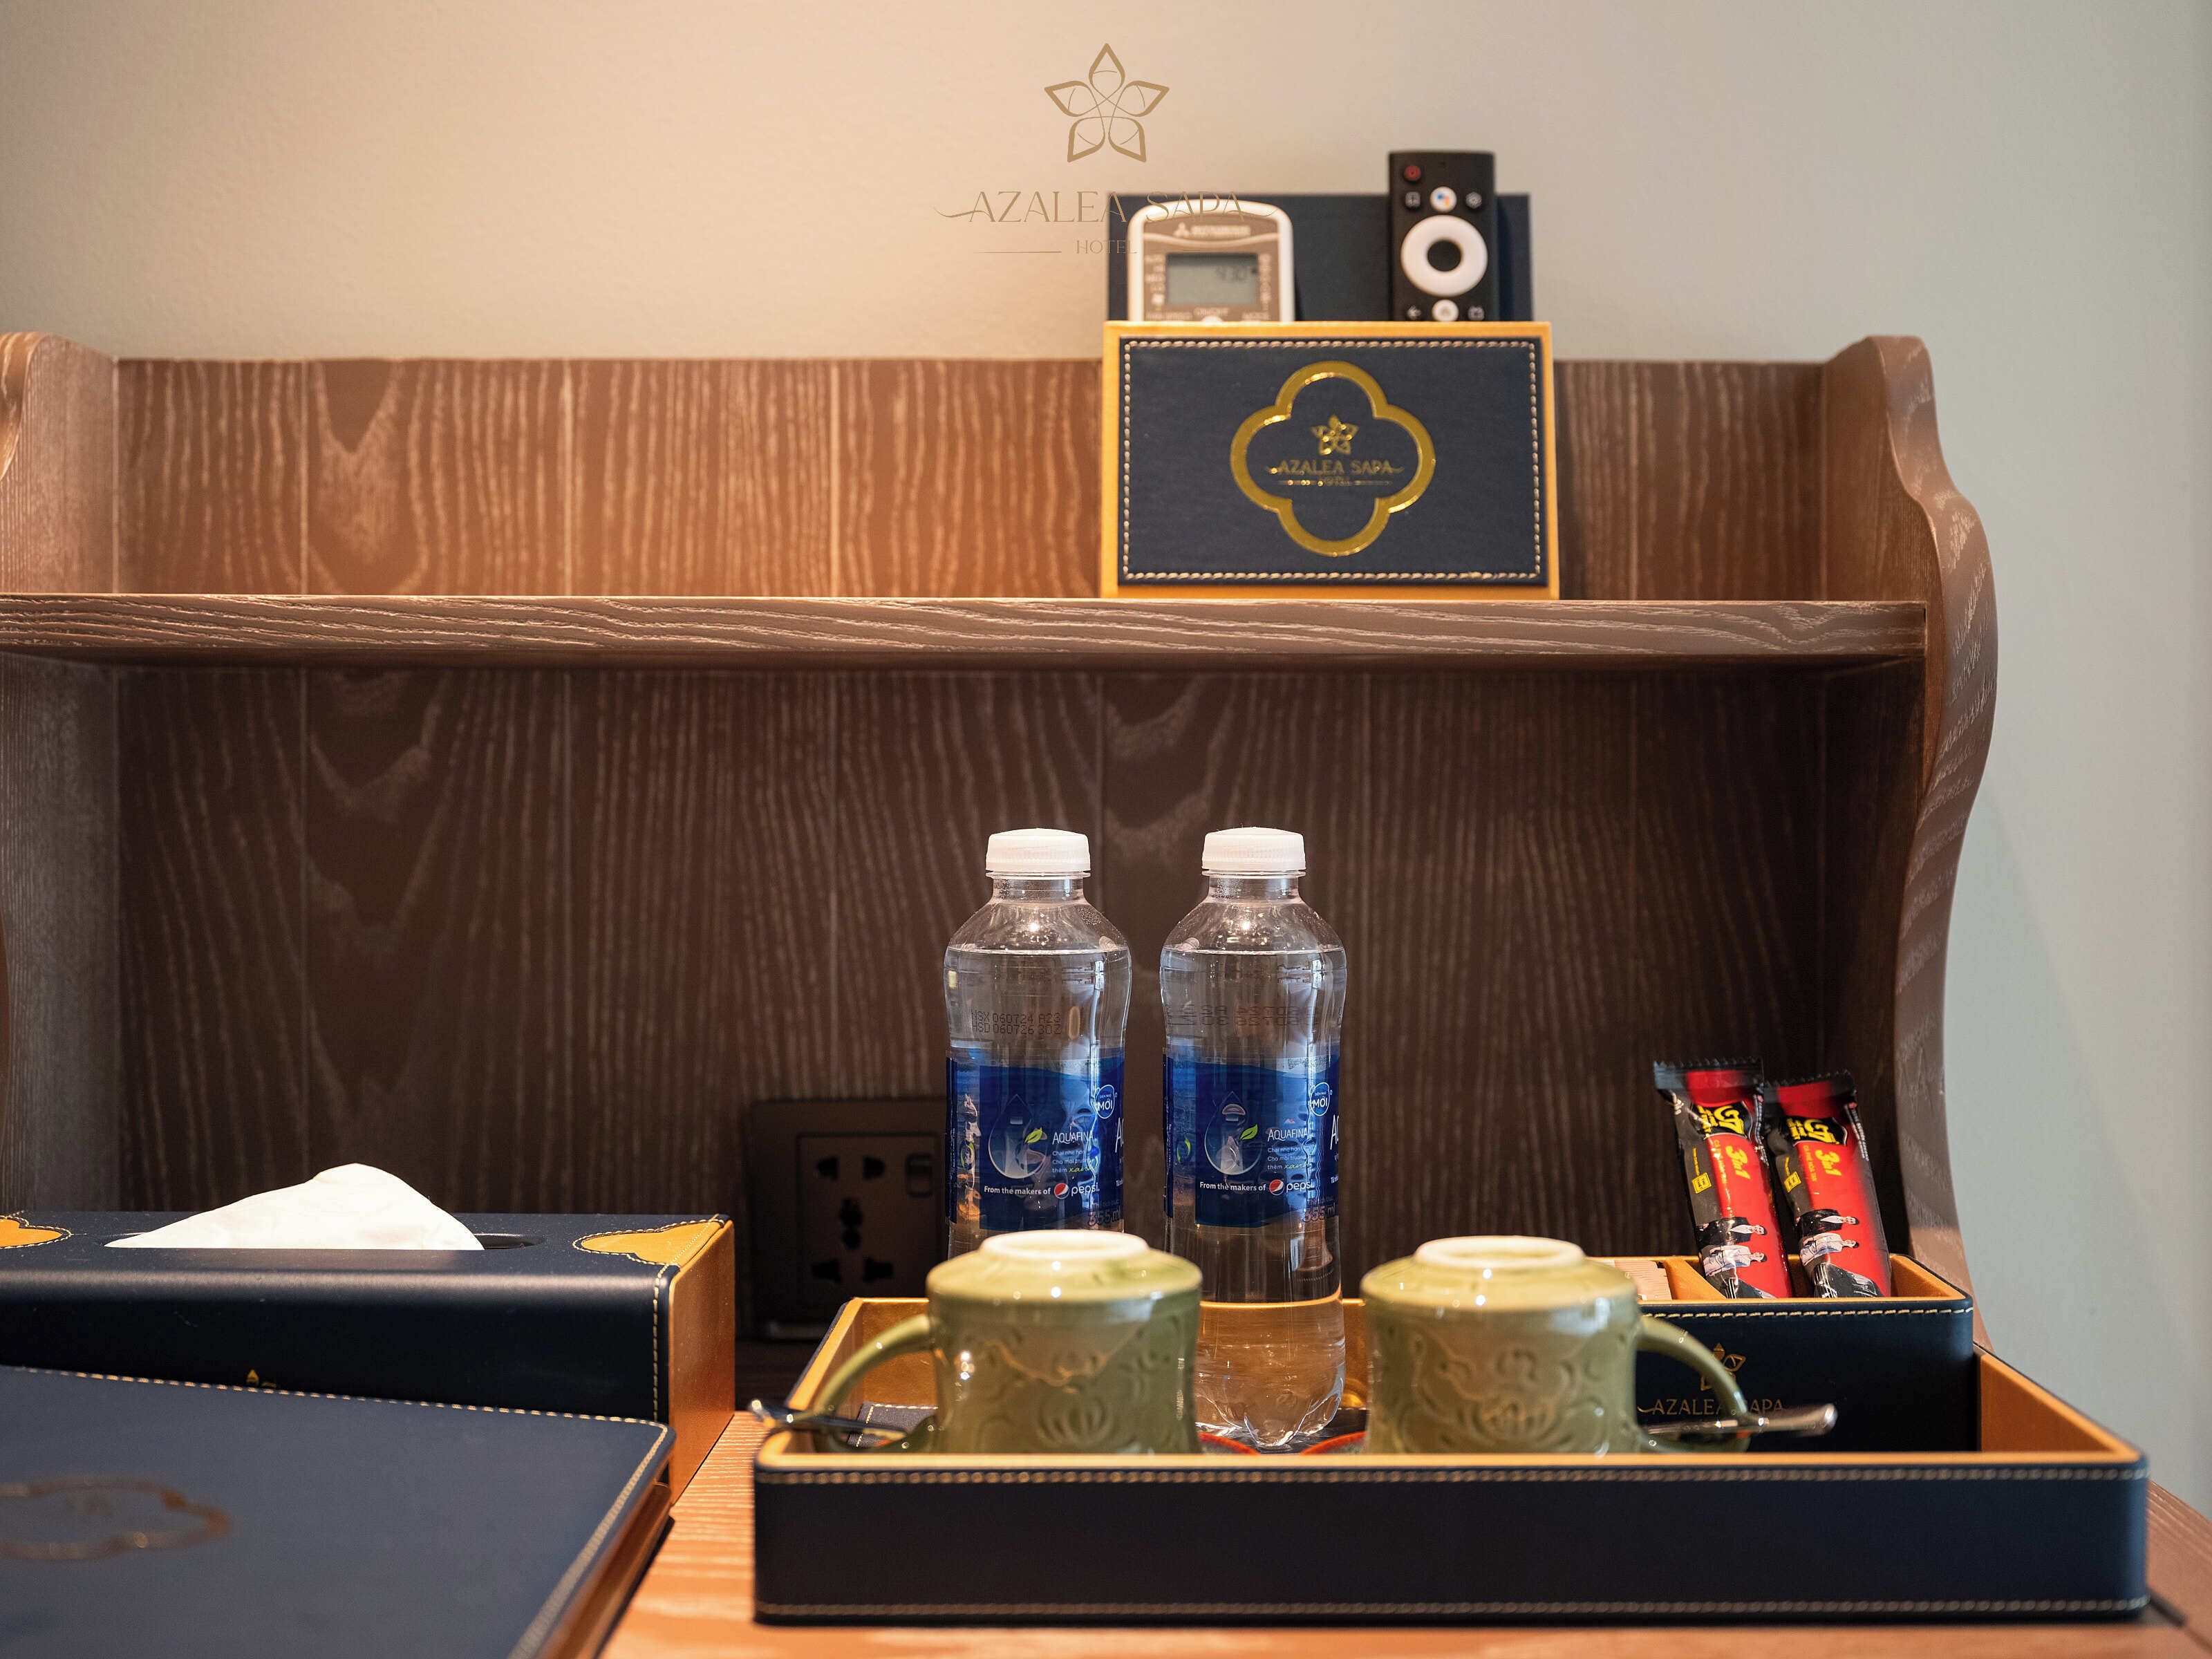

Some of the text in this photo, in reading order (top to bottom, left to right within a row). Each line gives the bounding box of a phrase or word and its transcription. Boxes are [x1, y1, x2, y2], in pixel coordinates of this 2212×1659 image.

[1279, 458, 1394, 476] AZALEA SAPA
[971, 1009, 991, 1022] NSX
[992, 1012, 1034, 1024] 060724
[971, 1021, 991, 1033] HSD
[993, 1023, 1035, 1035] 060726
[1052, 1130, 1093, 1145] AQUAFINA
[1267, 1127, 1309, 1142] AQUAFINA
[984, 1182, 1098, 1197] From the makers of pepsi
[1199, 1179, 1313, 1193] From the makers of pepsi
